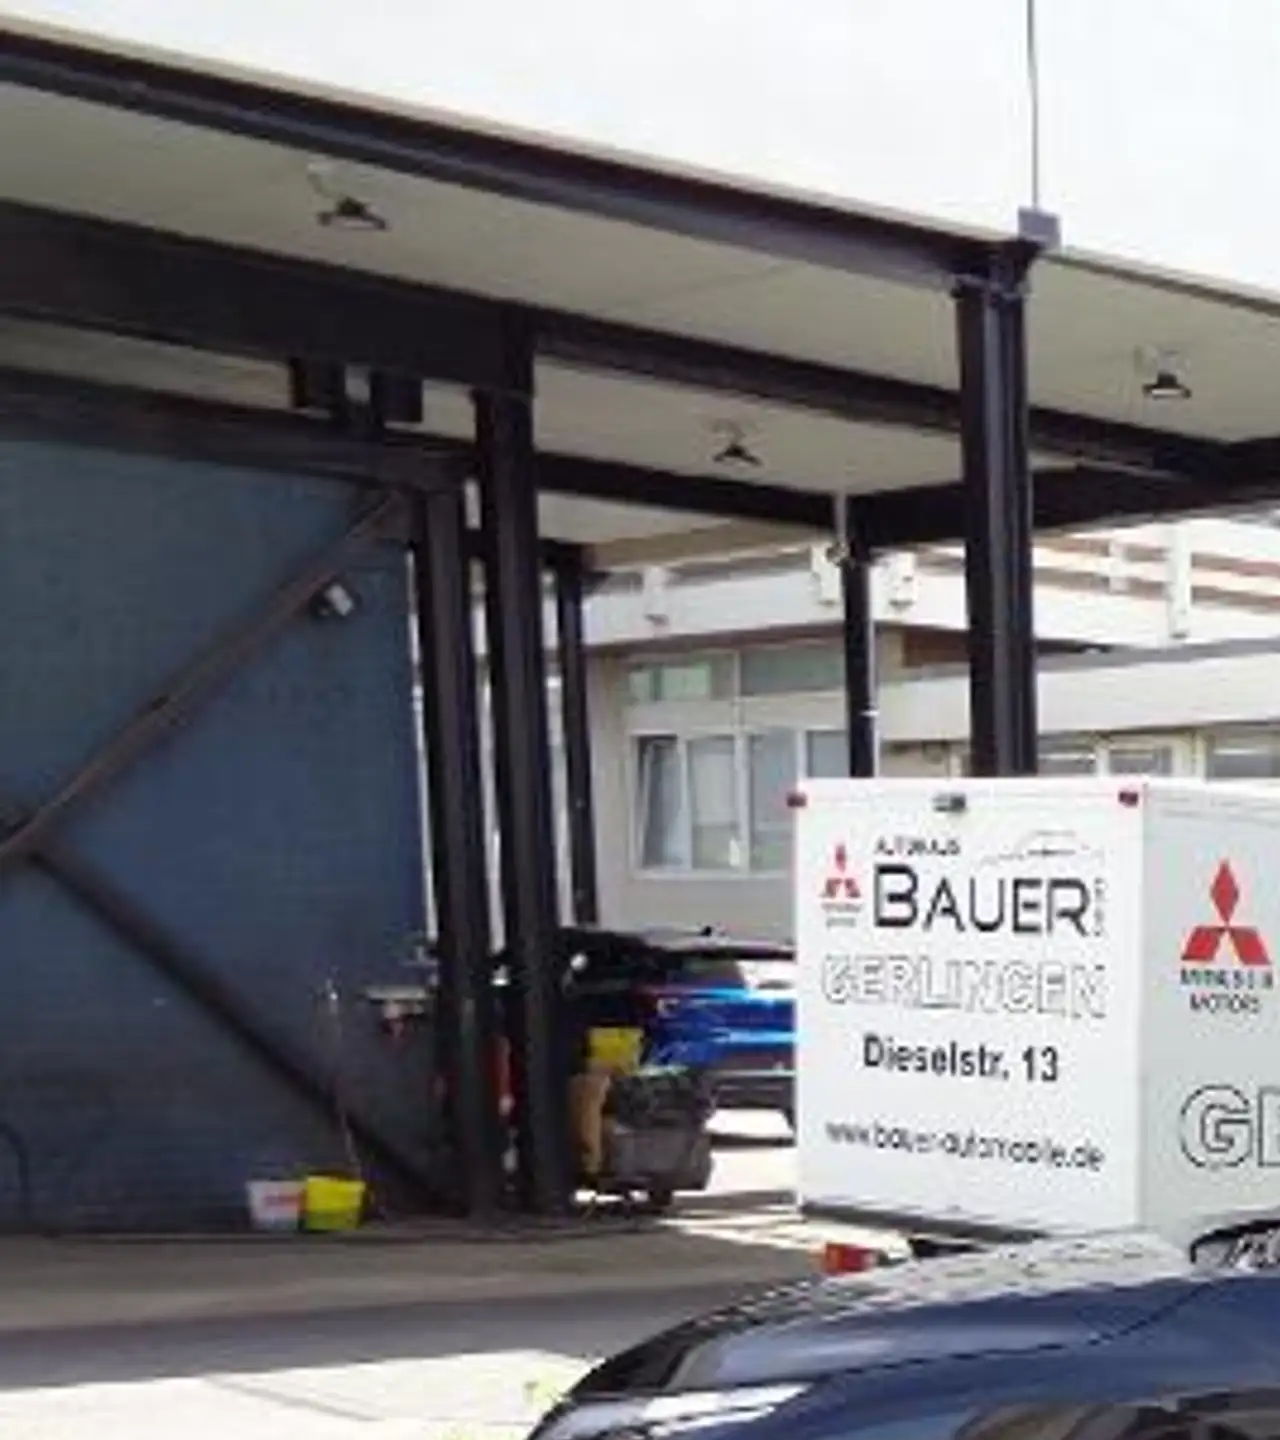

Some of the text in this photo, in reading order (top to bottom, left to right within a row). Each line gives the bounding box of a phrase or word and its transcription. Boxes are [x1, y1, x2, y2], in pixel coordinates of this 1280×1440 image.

[873, 863, 1091, 936] BAUER
[821, 955, 1105, 1020] GERLINGEN
[864, 1032, 1060, 1084] Dieselstr. 13
